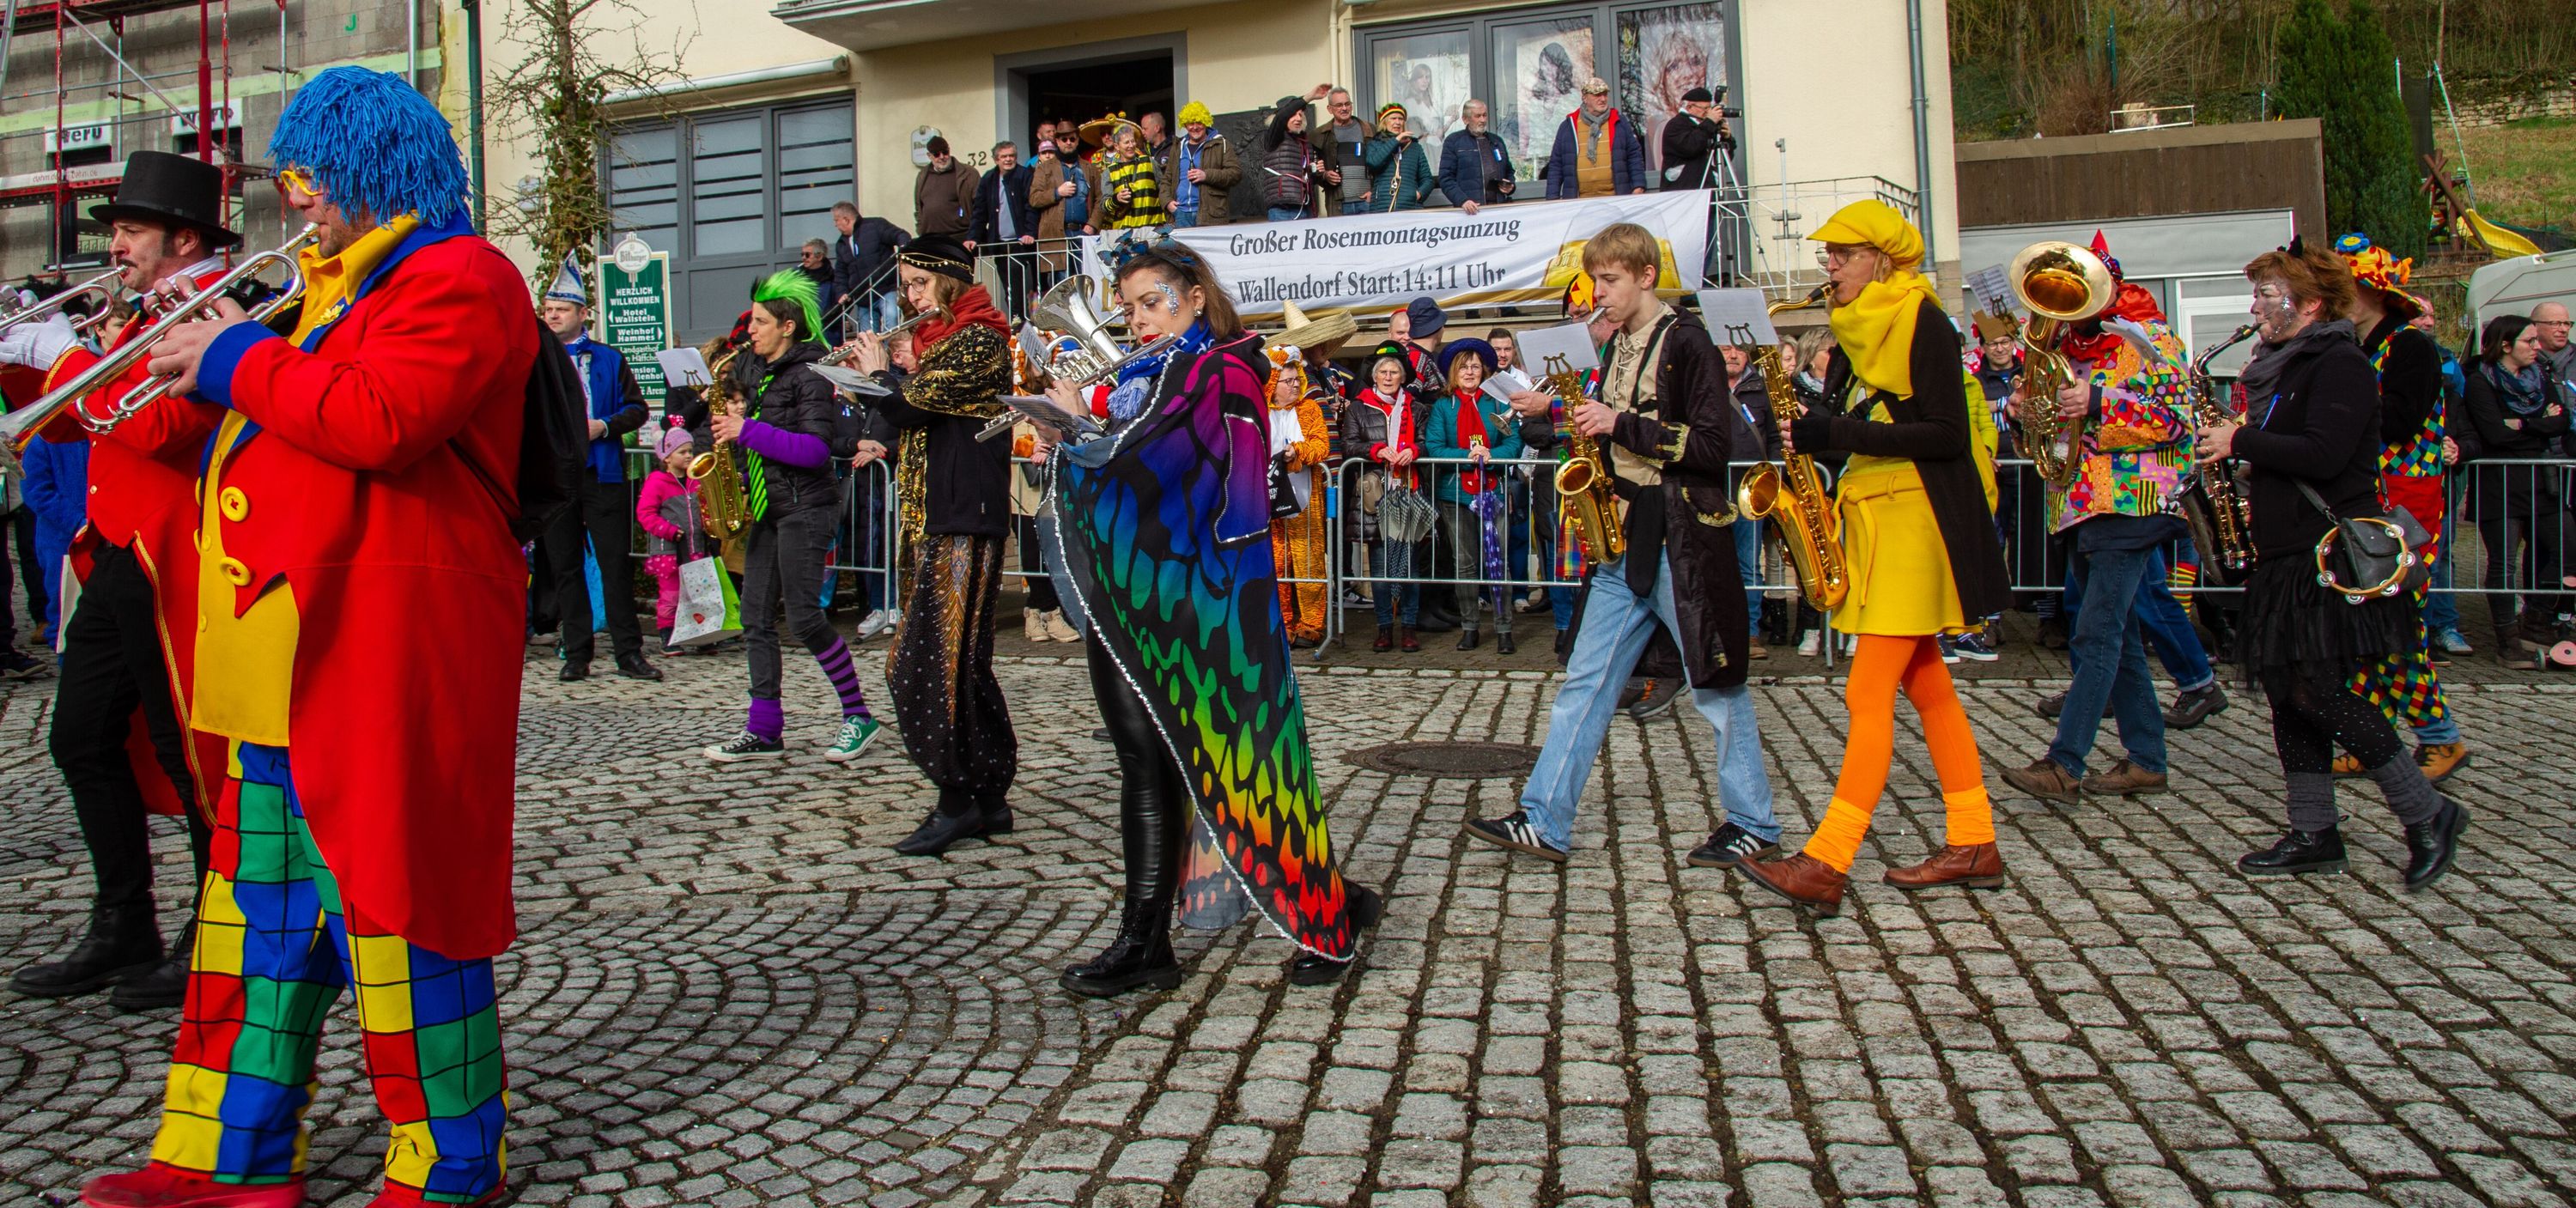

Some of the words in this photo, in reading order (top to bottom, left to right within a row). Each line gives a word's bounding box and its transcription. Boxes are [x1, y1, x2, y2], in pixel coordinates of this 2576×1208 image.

[968, 151, 987, 167] 32
[1230, 229, 1298, 257] Großer
[1303, 219, 1522, 250] Rosenmontagsumzug
[1237, 270, 1343, 304] Wallendorf
[1466, 261, 1506, 288] Uhr
[616, 287, 653, 296] HERZLICH
[610, 296, 660, 306] WILLKOMMEN
[615, 315, 656, 324] Wallstein
[617, 327, 655, 336] Weinhof
[620, 344, 660, 355] Landgasthof
